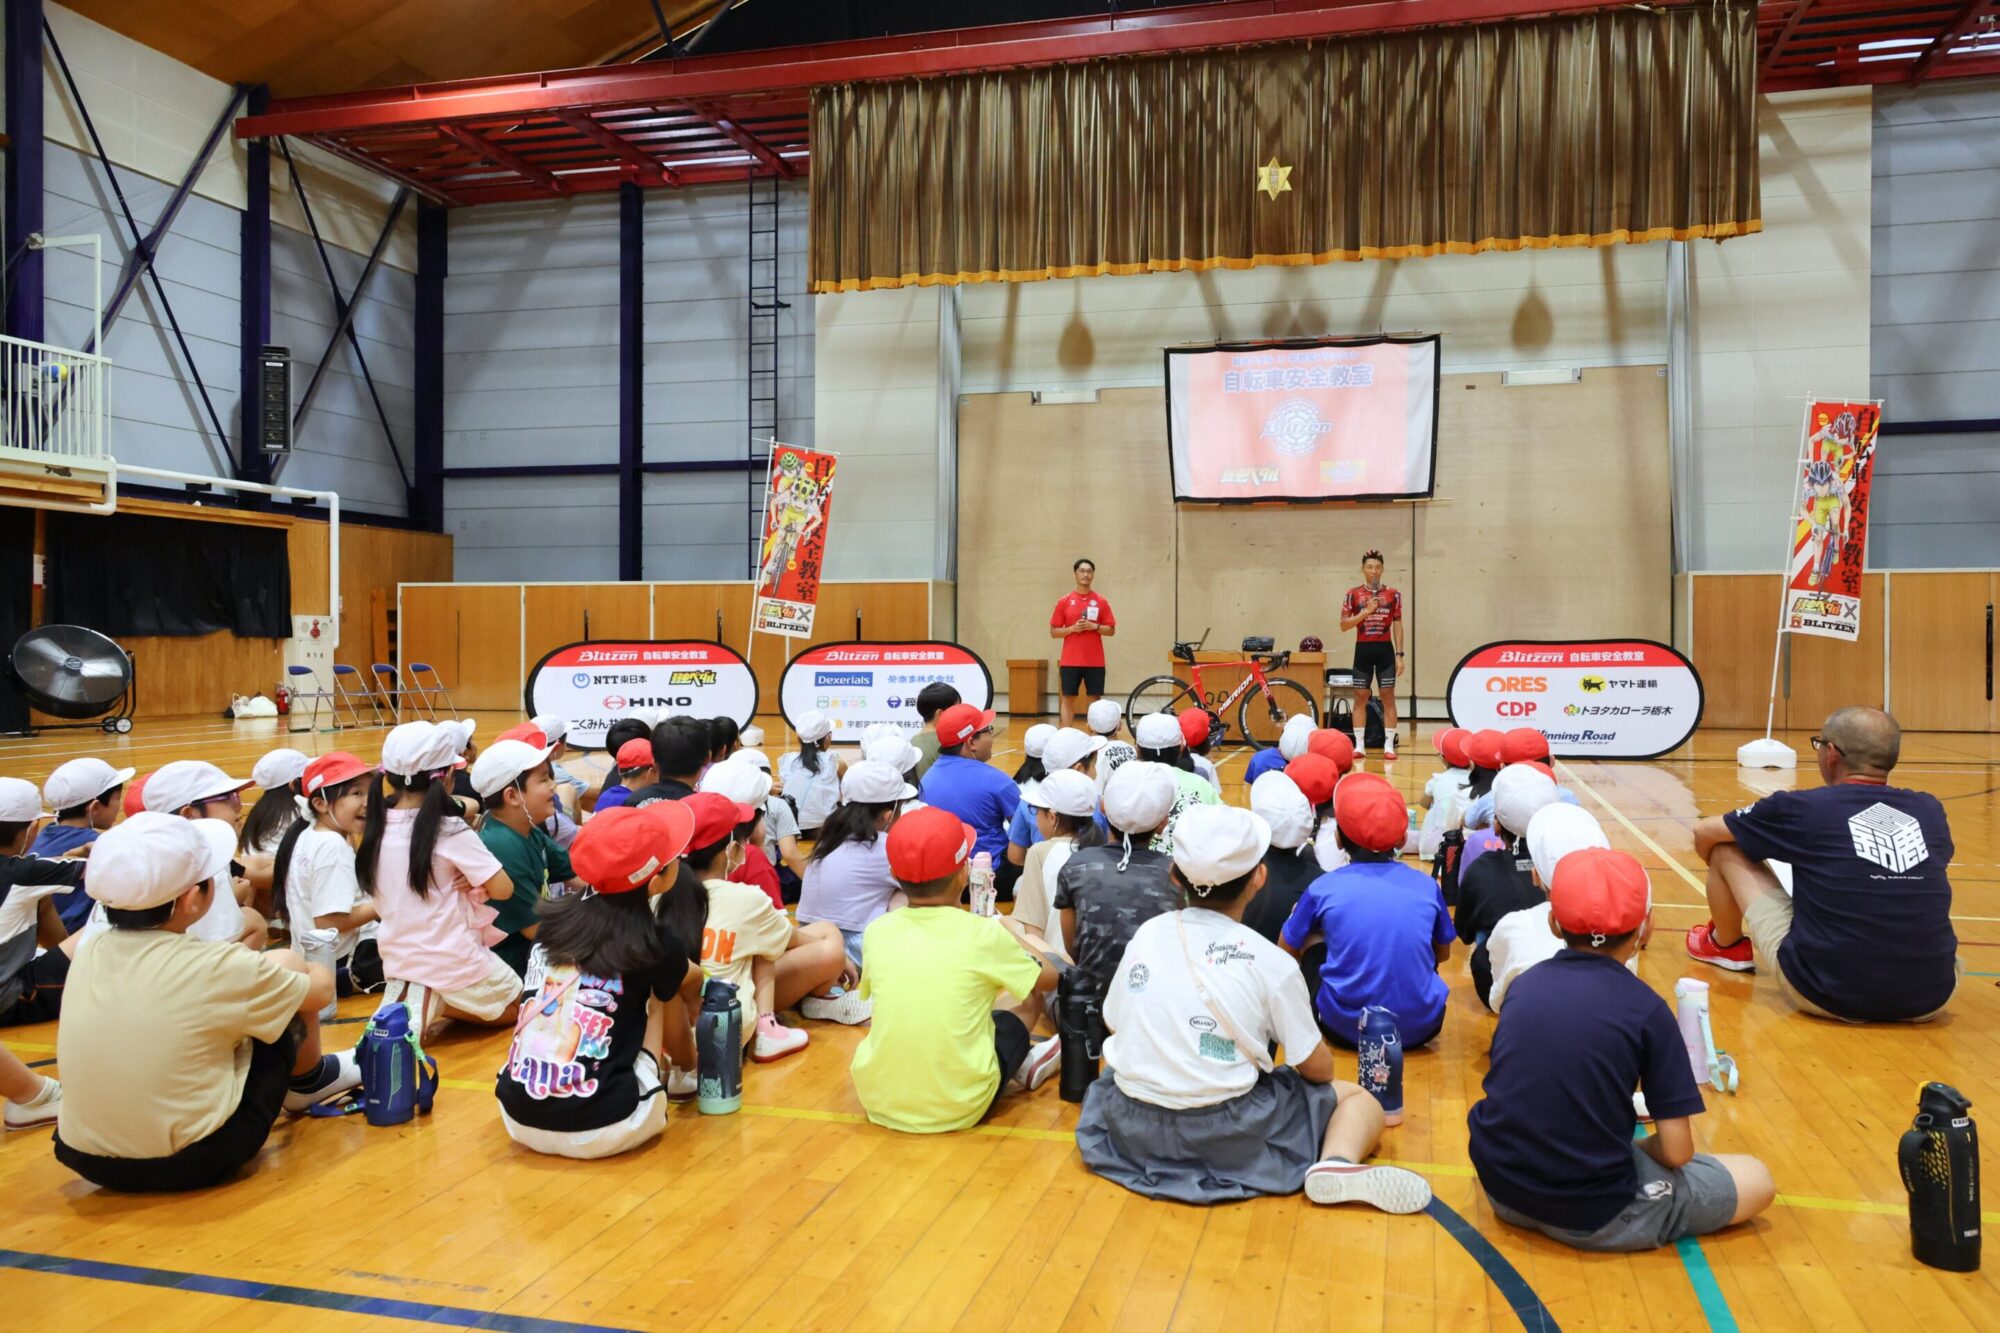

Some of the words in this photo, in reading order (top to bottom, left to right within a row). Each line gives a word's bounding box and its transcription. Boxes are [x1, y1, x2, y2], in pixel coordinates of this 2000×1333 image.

[1223, 363, 1373, 393] 自転車安全教室
[766, 620, 809, 633] BLITZEN
[1803, 619, 1856, 634] BLITZEN
[577, 651, 638, 662] Blitzen
[643, 650, 709, 660] 自転車安全教室
[824, 651, 880, 661] Blitzen
[884, 652, 944, 660] 自転車安全教室
[1496, 651, 1564, 663] Blitzen
[1570, 651, 1645, 662] 自転車安全教室
[593, 676, 619, 685] NTT
[620, 674, 647, 684] 東日本
[818, 675, 870, 685] Dexerials
[1486, 676, 1548, 693] ORES
[1608, 679, 1658, 688] ヤマト運輸
[1218, 673, 1253, 716] MERIDA
[629, 697, 692, 707] HINO
[1496, 701, 1537, 717] CDP
[1581, 705, 1674, 716] トヨタカローラ栃木
[1581, 730, 1616, 741] Road
